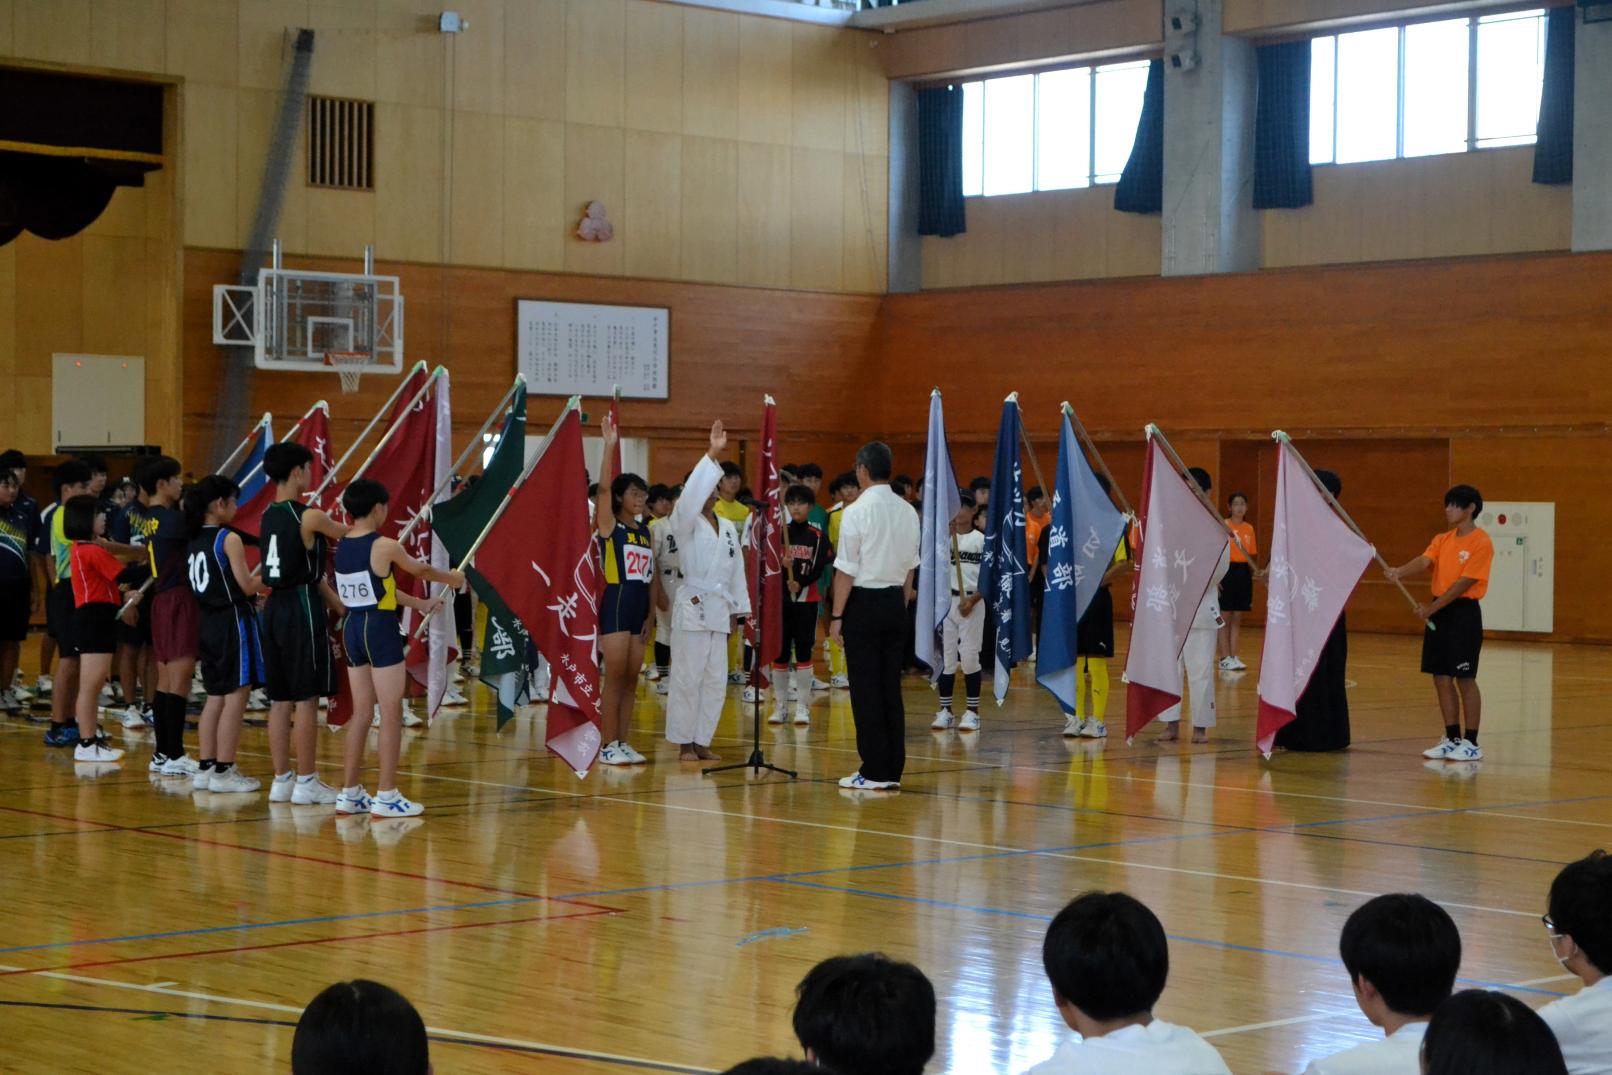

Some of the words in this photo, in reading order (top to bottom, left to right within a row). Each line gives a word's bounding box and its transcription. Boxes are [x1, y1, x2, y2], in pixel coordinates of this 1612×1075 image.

[188, 551, 209, 593] 10
[266, 534, 281, 578] 4
[340, 582, 369, 599] 276
